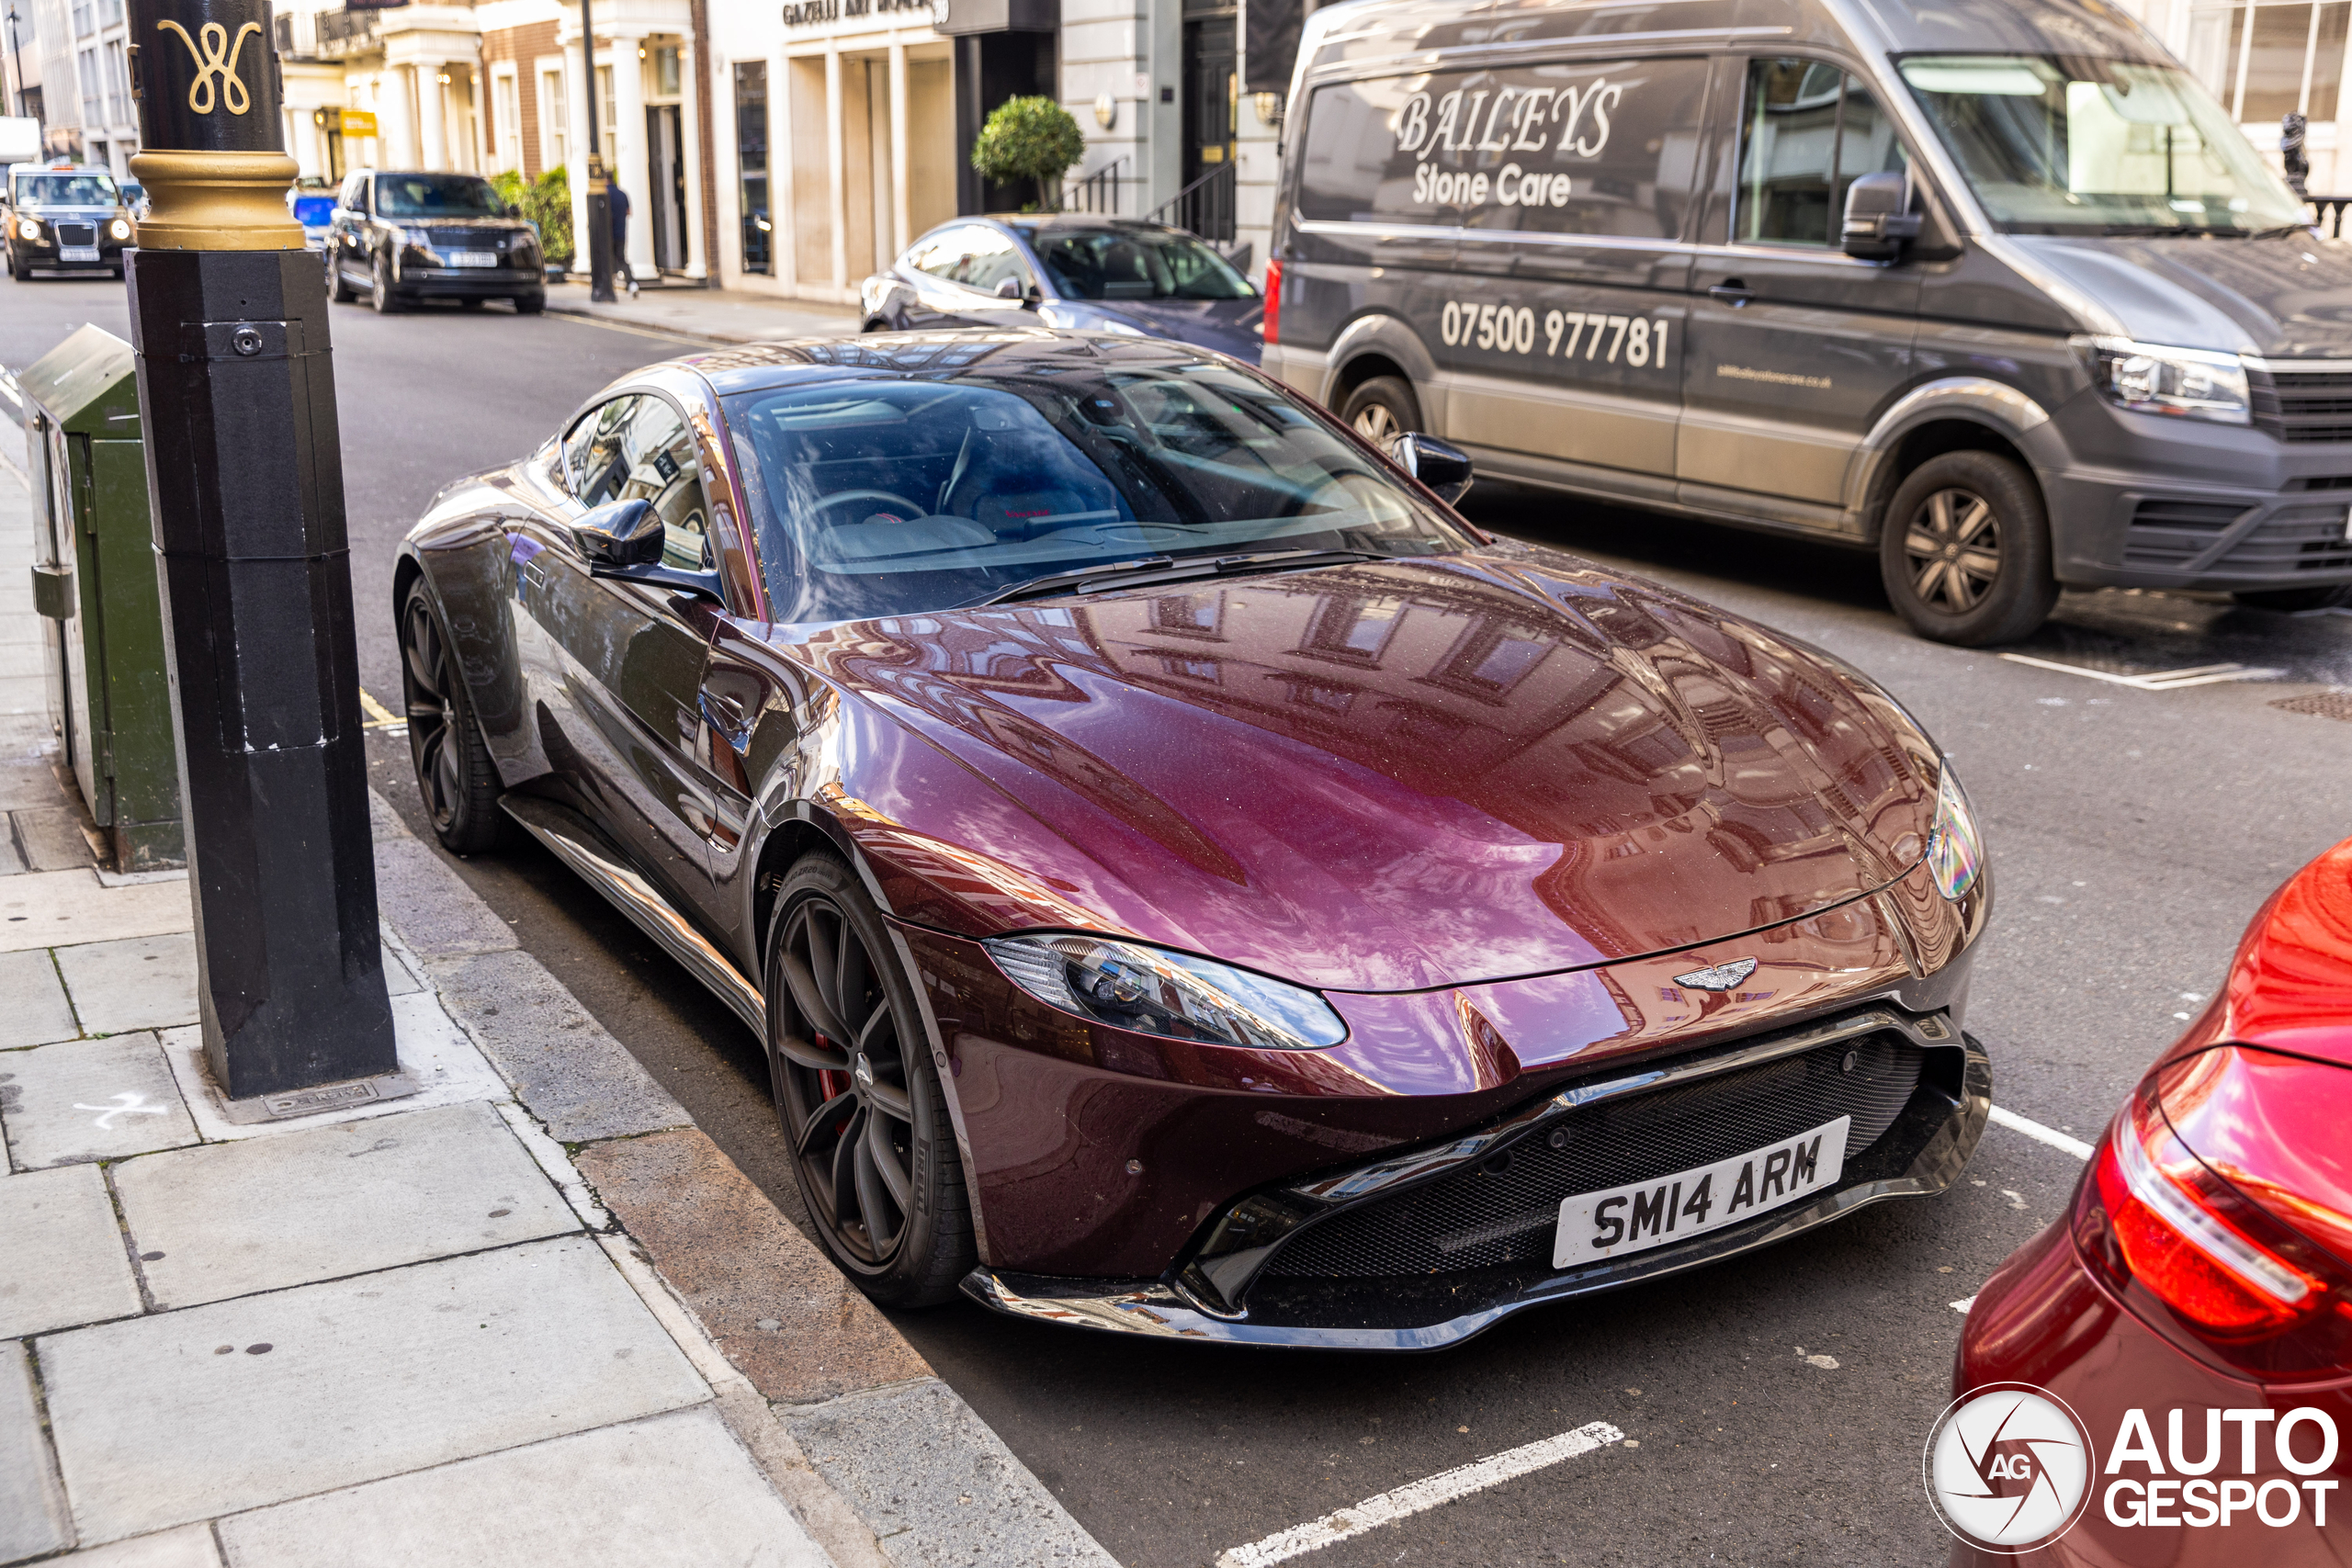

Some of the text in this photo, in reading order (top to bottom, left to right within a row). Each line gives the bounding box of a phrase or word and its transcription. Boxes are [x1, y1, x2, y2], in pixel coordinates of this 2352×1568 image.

[1396, 77, 1623, 161] BAILEYS
[1412, 162, 1572, 208] Stone Care
[1442, 300, 1669, 368] 07500 977781
[798, 866, 818, 875] ZR20
[917, 1136, 932, 1217] PIRELLI
[1591, 1134, 1822, 1248] SM14 ARM
